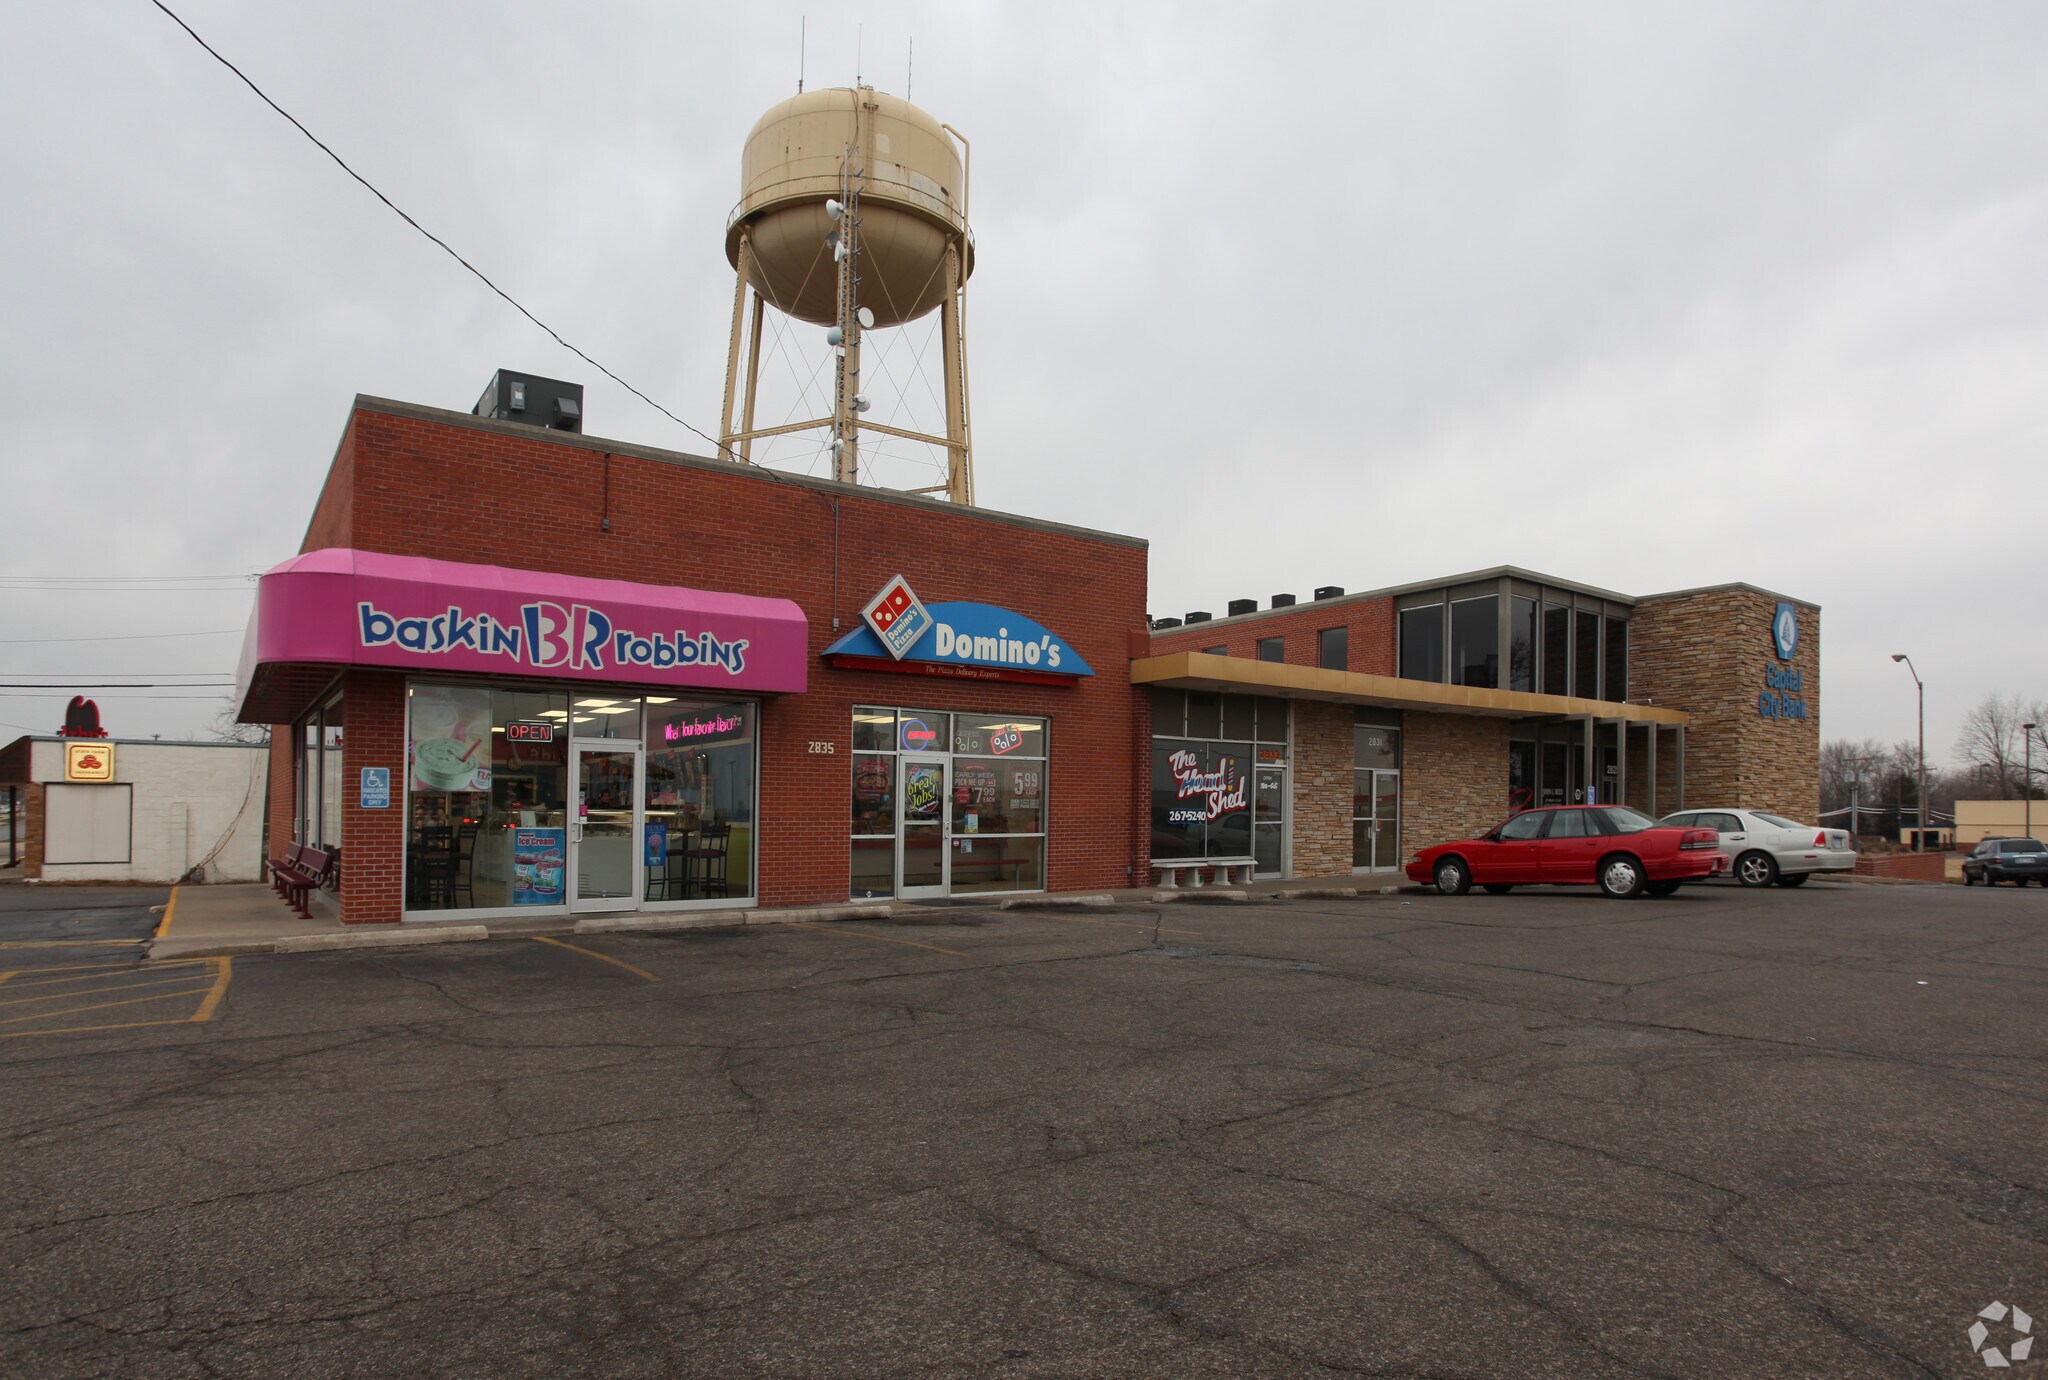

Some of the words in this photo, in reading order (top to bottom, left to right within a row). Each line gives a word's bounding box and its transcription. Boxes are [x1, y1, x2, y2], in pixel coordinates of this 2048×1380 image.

[521, 601, 612, 671] BR
[887, 609, 918, 641] Domino's
[893, 628, 914, 649] Pizza
[936, 623, 1061, 668] Domino's
[925, 664, 936, 673] The
[938, 665, 954, 675] Pizza
[956, 667, 978, 678] Delivery
[979, 669, 1000, 679] Experts
[1766, 661, 1803, 694] Capital
[1759, 690, 1780, 721] City
[1782, 693, 1807, 720] Bank
[509, 725, 550, 740] OPEN
[1368, 737, 1383, 746] 2831
[808, 741, 835, 754] 2835
[1168, 749, 1197, 772] The
[908, 773, 933, 796] Great
[954, 771, 976, 779] EARLY
[1174, 757, 1227, 798] Head
[912, 784, 936, 808] Jobs!
[1206, 775, 1247, 819] Shed
